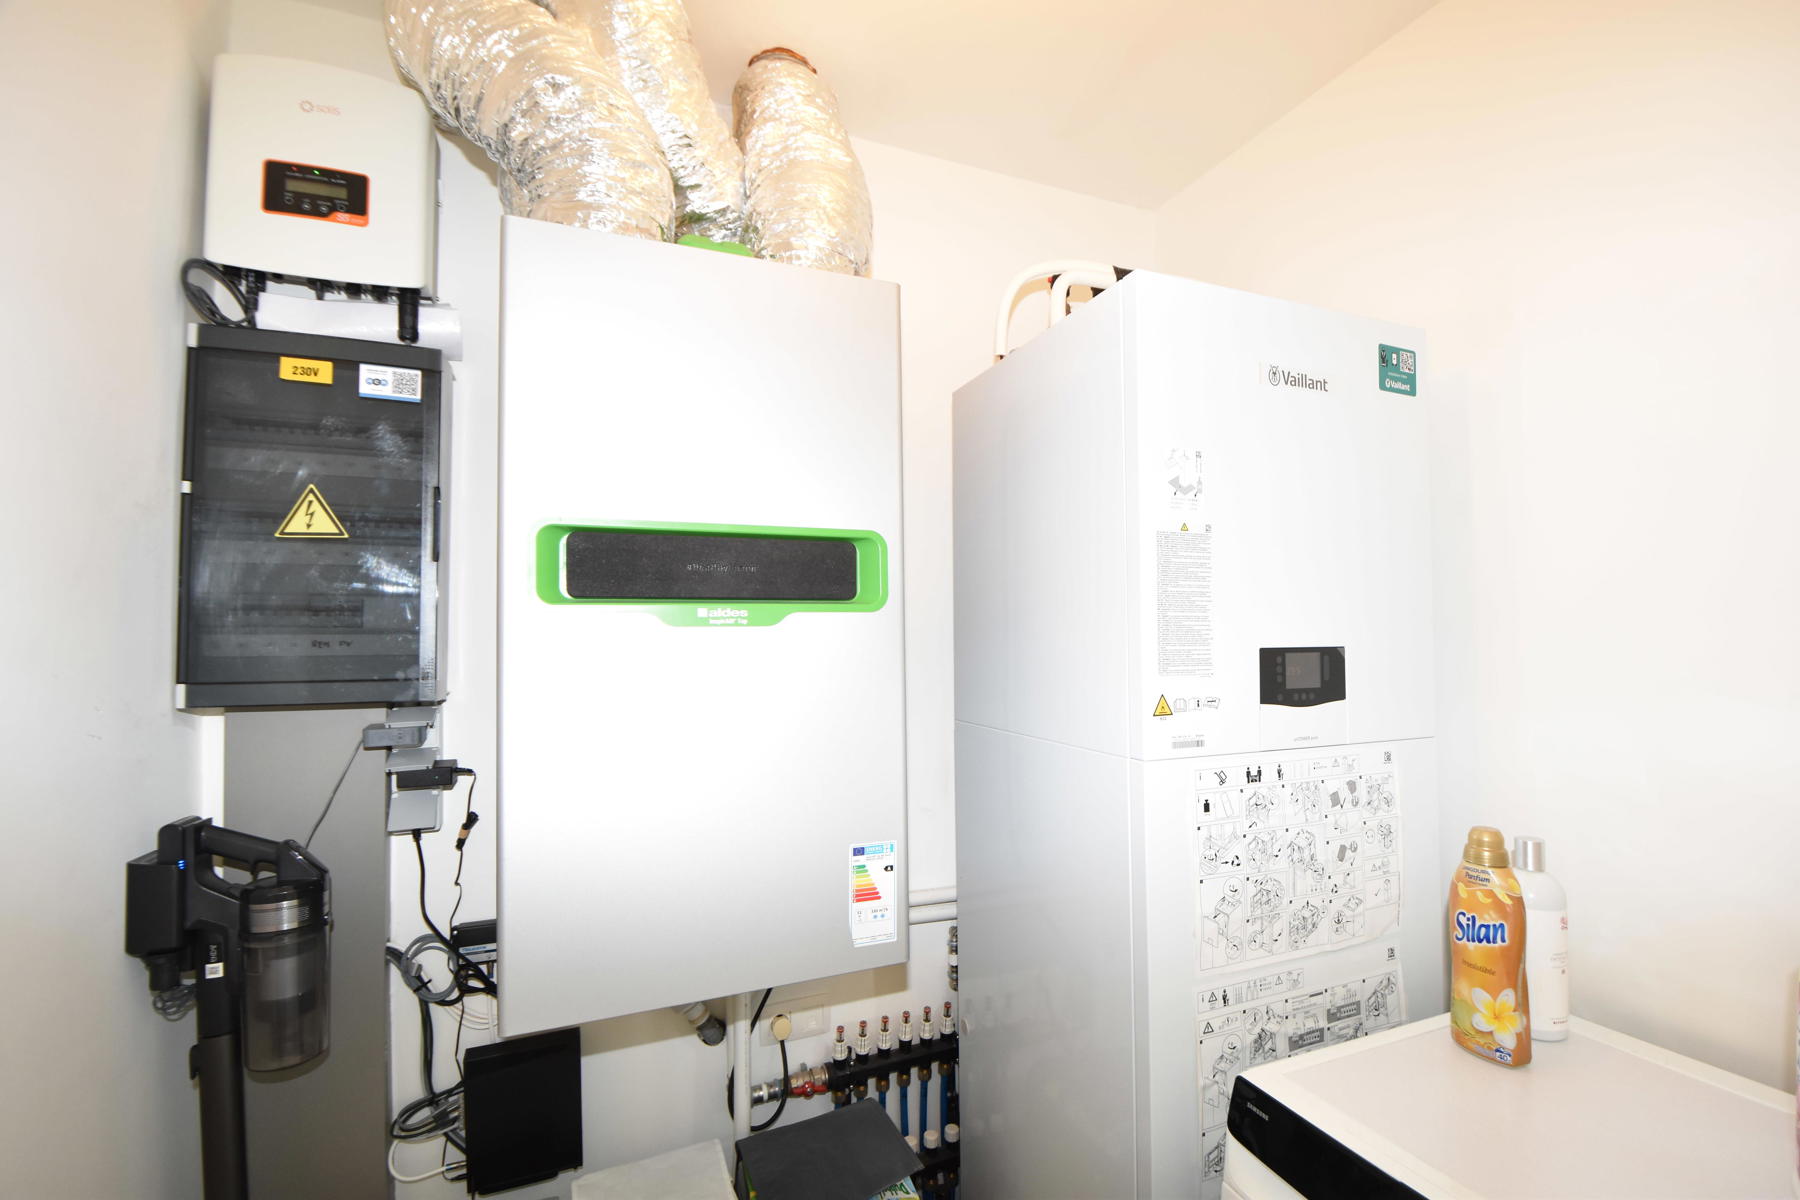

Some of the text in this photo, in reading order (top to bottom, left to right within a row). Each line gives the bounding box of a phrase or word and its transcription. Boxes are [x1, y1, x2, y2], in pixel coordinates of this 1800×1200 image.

[291, 366, 320, 377] 230V
[1282, 369, 1329, 392] Vaillant
[1391, 380, 1411, 391] Vaillant
[708, 607, 748, 617] aldes
[1454, 910, 1507, 945] Silan
[1247, 1101, 1269, 1121] SAMSUNG
